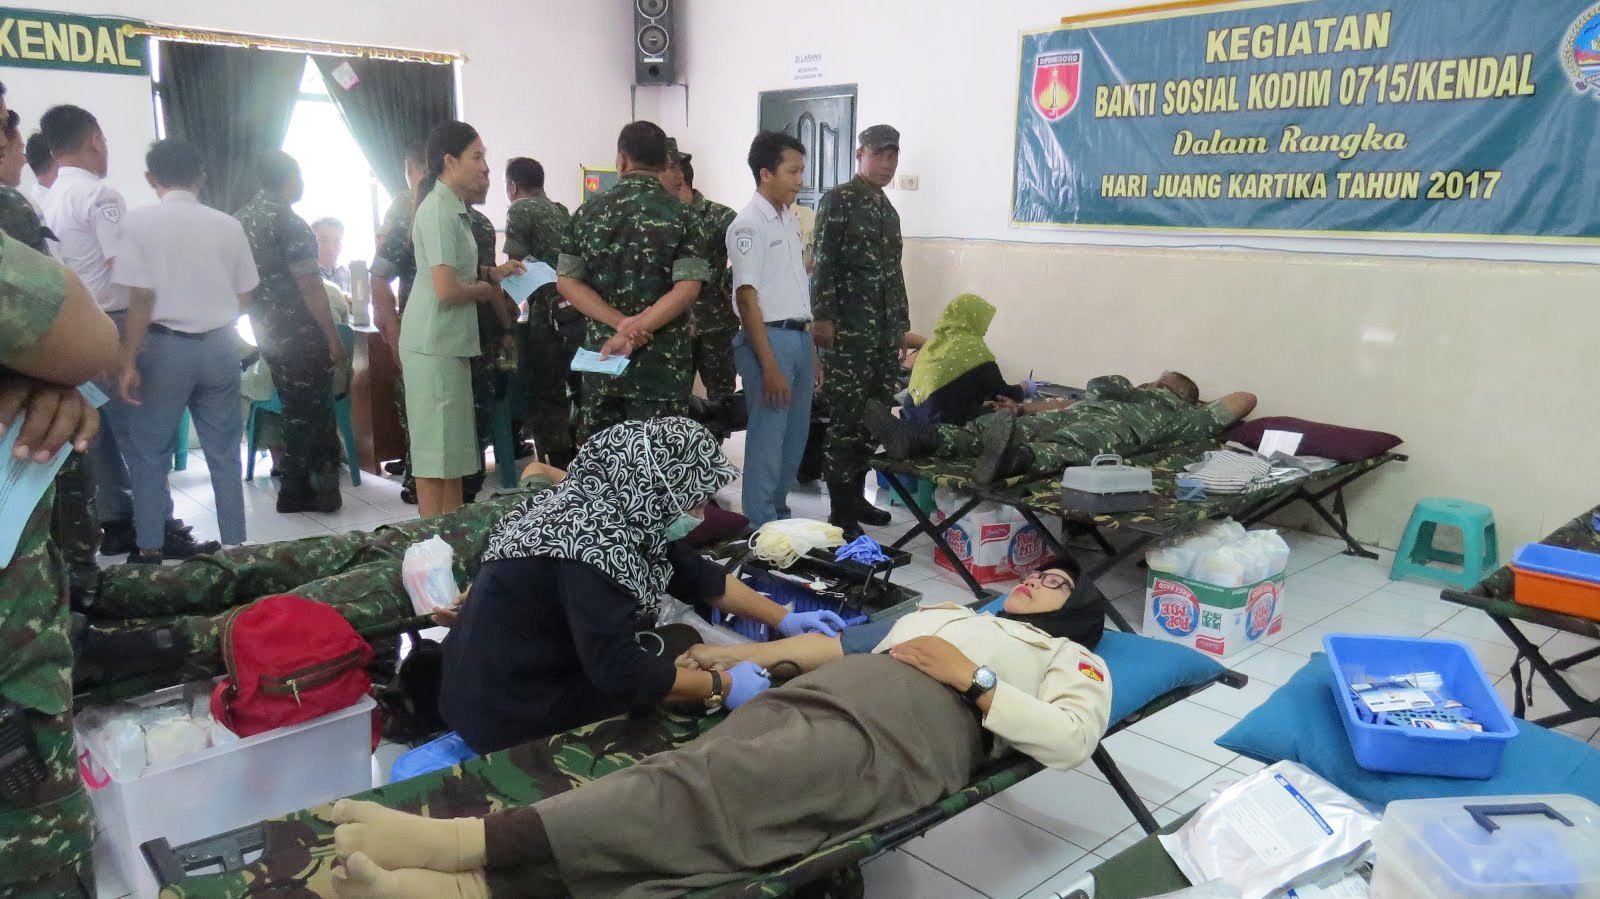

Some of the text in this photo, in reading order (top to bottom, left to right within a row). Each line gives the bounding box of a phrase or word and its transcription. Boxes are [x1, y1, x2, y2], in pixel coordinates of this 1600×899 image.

[0, 18, 141, 67] KENDAL
[1205, 11, 1391, 63] KEGIATAN
[1039, 55, 1078, 65] DIPONEGORO
[1095, 53, 1535, 118] BAKTI SOSIAL KODIM 0715/KENDAL
[1173, 122, 1408, 160] Dalam Rangka
[1101, 170, 1502, 199] HARI JUANG KARTIKA TAHUN 2017
[1160, 602, 1187, 618] MIE
[1166, 615, 1191, 632] POP
